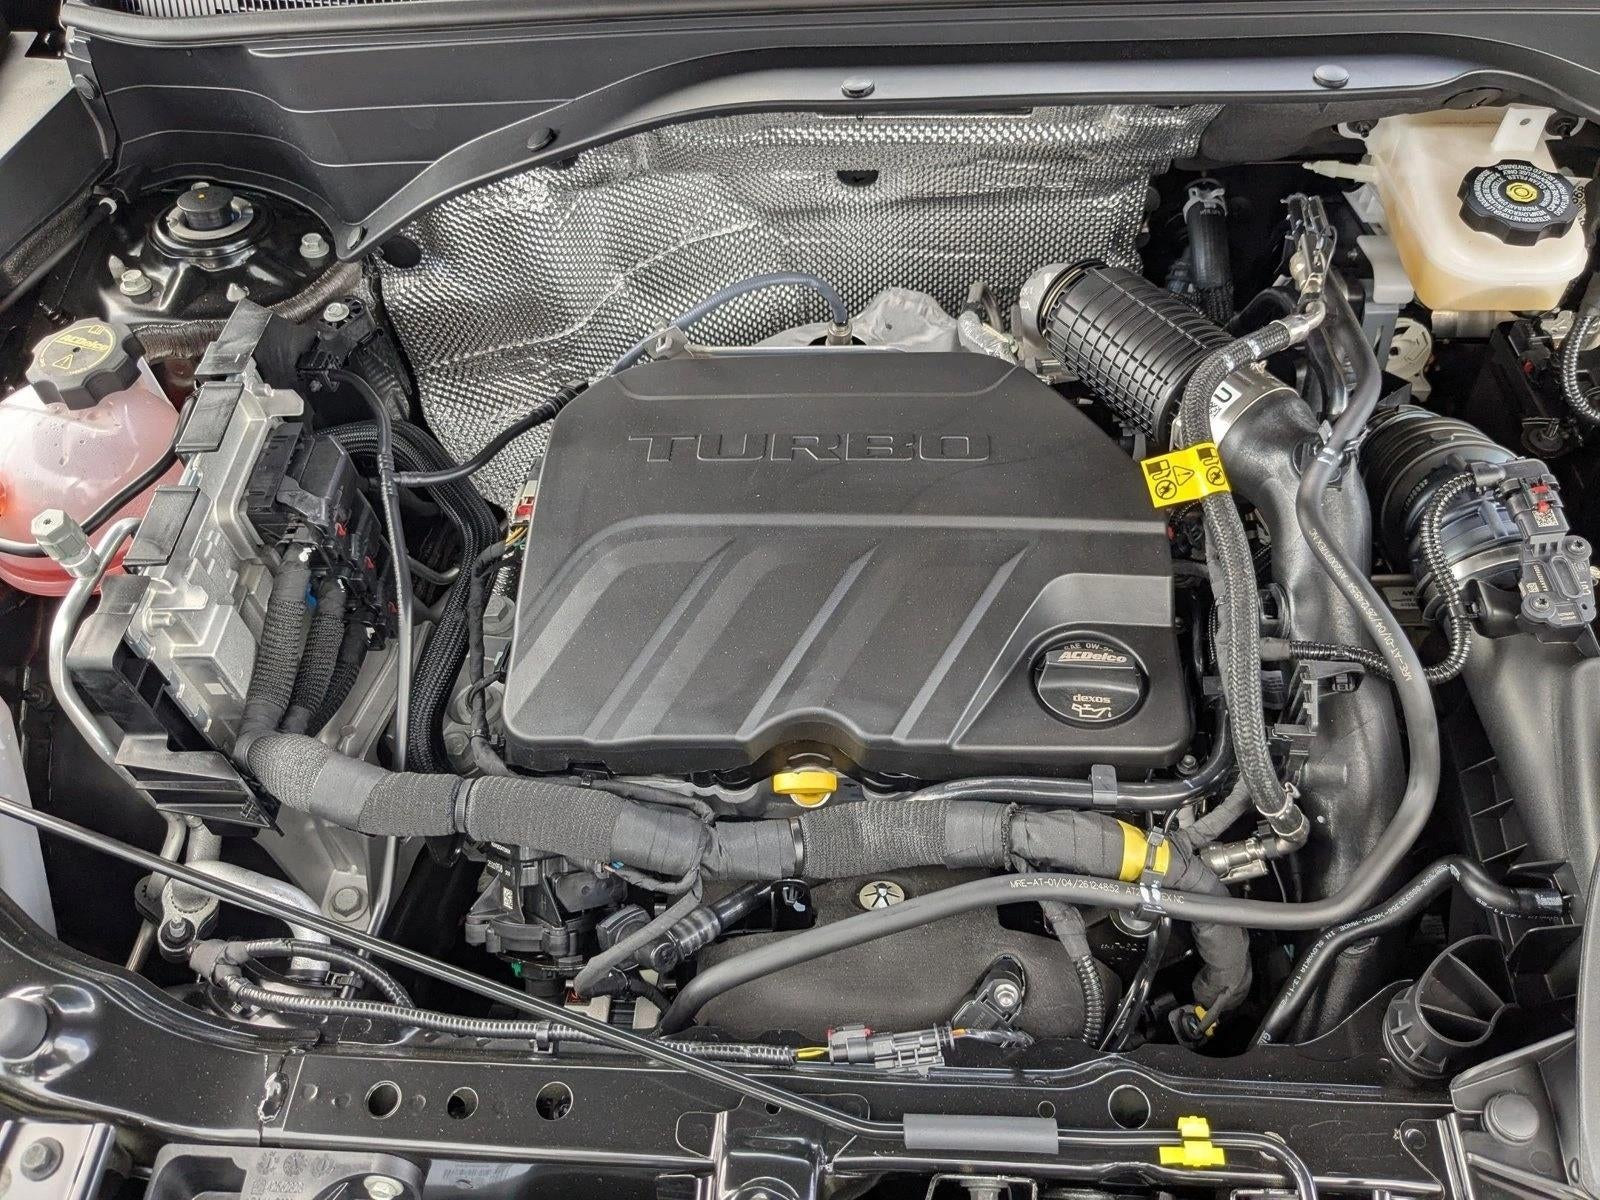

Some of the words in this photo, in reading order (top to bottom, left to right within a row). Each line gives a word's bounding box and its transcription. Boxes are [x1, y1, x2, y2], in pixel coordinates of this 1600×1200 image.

[1554, 183, 1567, 194] FROM
[629, 433, 991, 462] TURBO
[1058, 651, 1127, 663] ACDelco
[1073, 694, 1111, 704] dexos
[1172, 894, 1185, 905] NC
[1323, 928, 1336, 940] IN
[1300, 939, 1325, 974] SLOVAKIA
